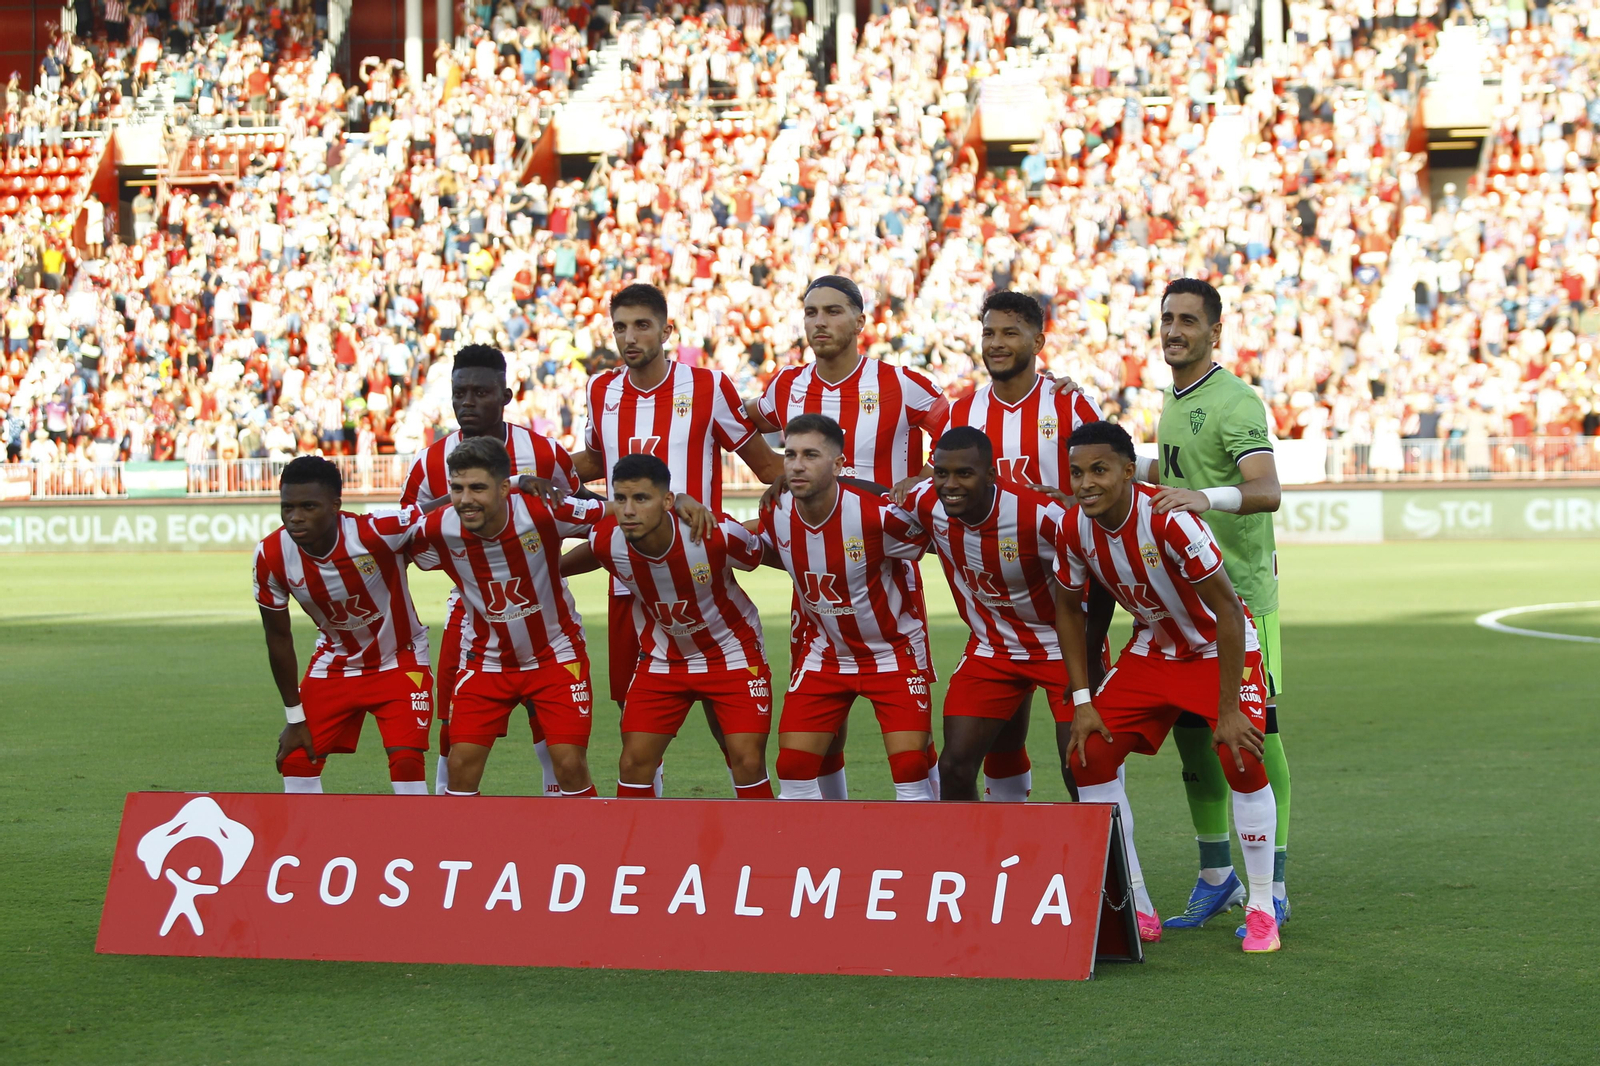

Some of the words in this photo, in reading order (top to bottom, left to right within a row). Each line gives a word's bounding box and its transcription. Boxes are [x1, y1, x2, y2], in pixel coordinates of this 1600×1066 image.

[0, 514, 157, 544] CIRCULAR
[167, 513, 283, 543] ECONO
[1273, 501, 1350, 531] ASIS
[1440, 501, 1492, 529] TCI
[1524, 498, 1600, 531] CIR
[487, 576, 530, 613] JK
[804, 571, 842, 604] JK
[327, 594, 371, 623] JK
[655, 599, 696, 628] JK
[547, 784, 561, 793] UD
